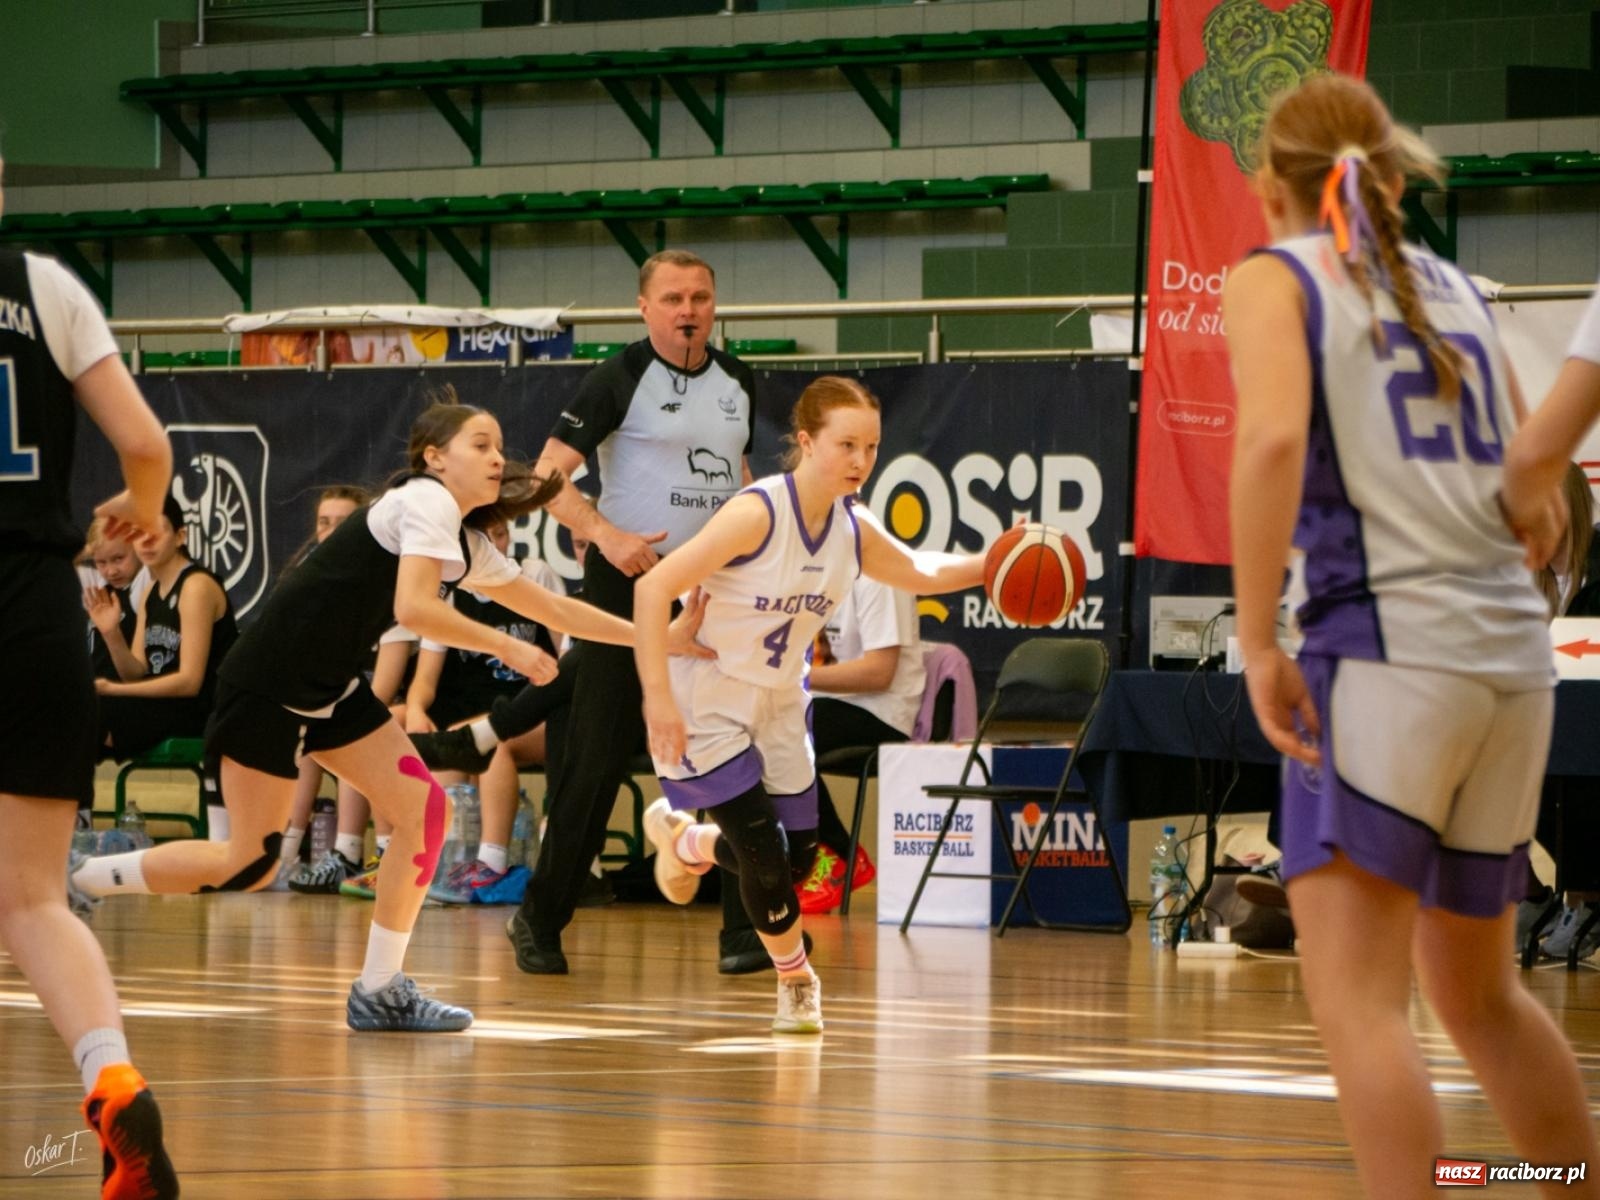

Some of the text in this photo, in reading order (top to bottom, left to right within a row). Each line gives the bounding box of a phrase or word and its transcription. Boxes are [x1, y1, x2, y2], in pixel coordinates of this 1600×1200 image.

[1158, 303, 1196, 332] od
[1372, 320, 1504, 466] 20
[670, 492, 708, 510] Bank
[868, 453, 1104, 581] OSiR
[963, 594, 1105, 631] RARZ
[763, 617, 788, 669] 4
[893, 840, 975, 858] BASKEBALL
[1014, 850, 1111, 868] BAKETBALL
